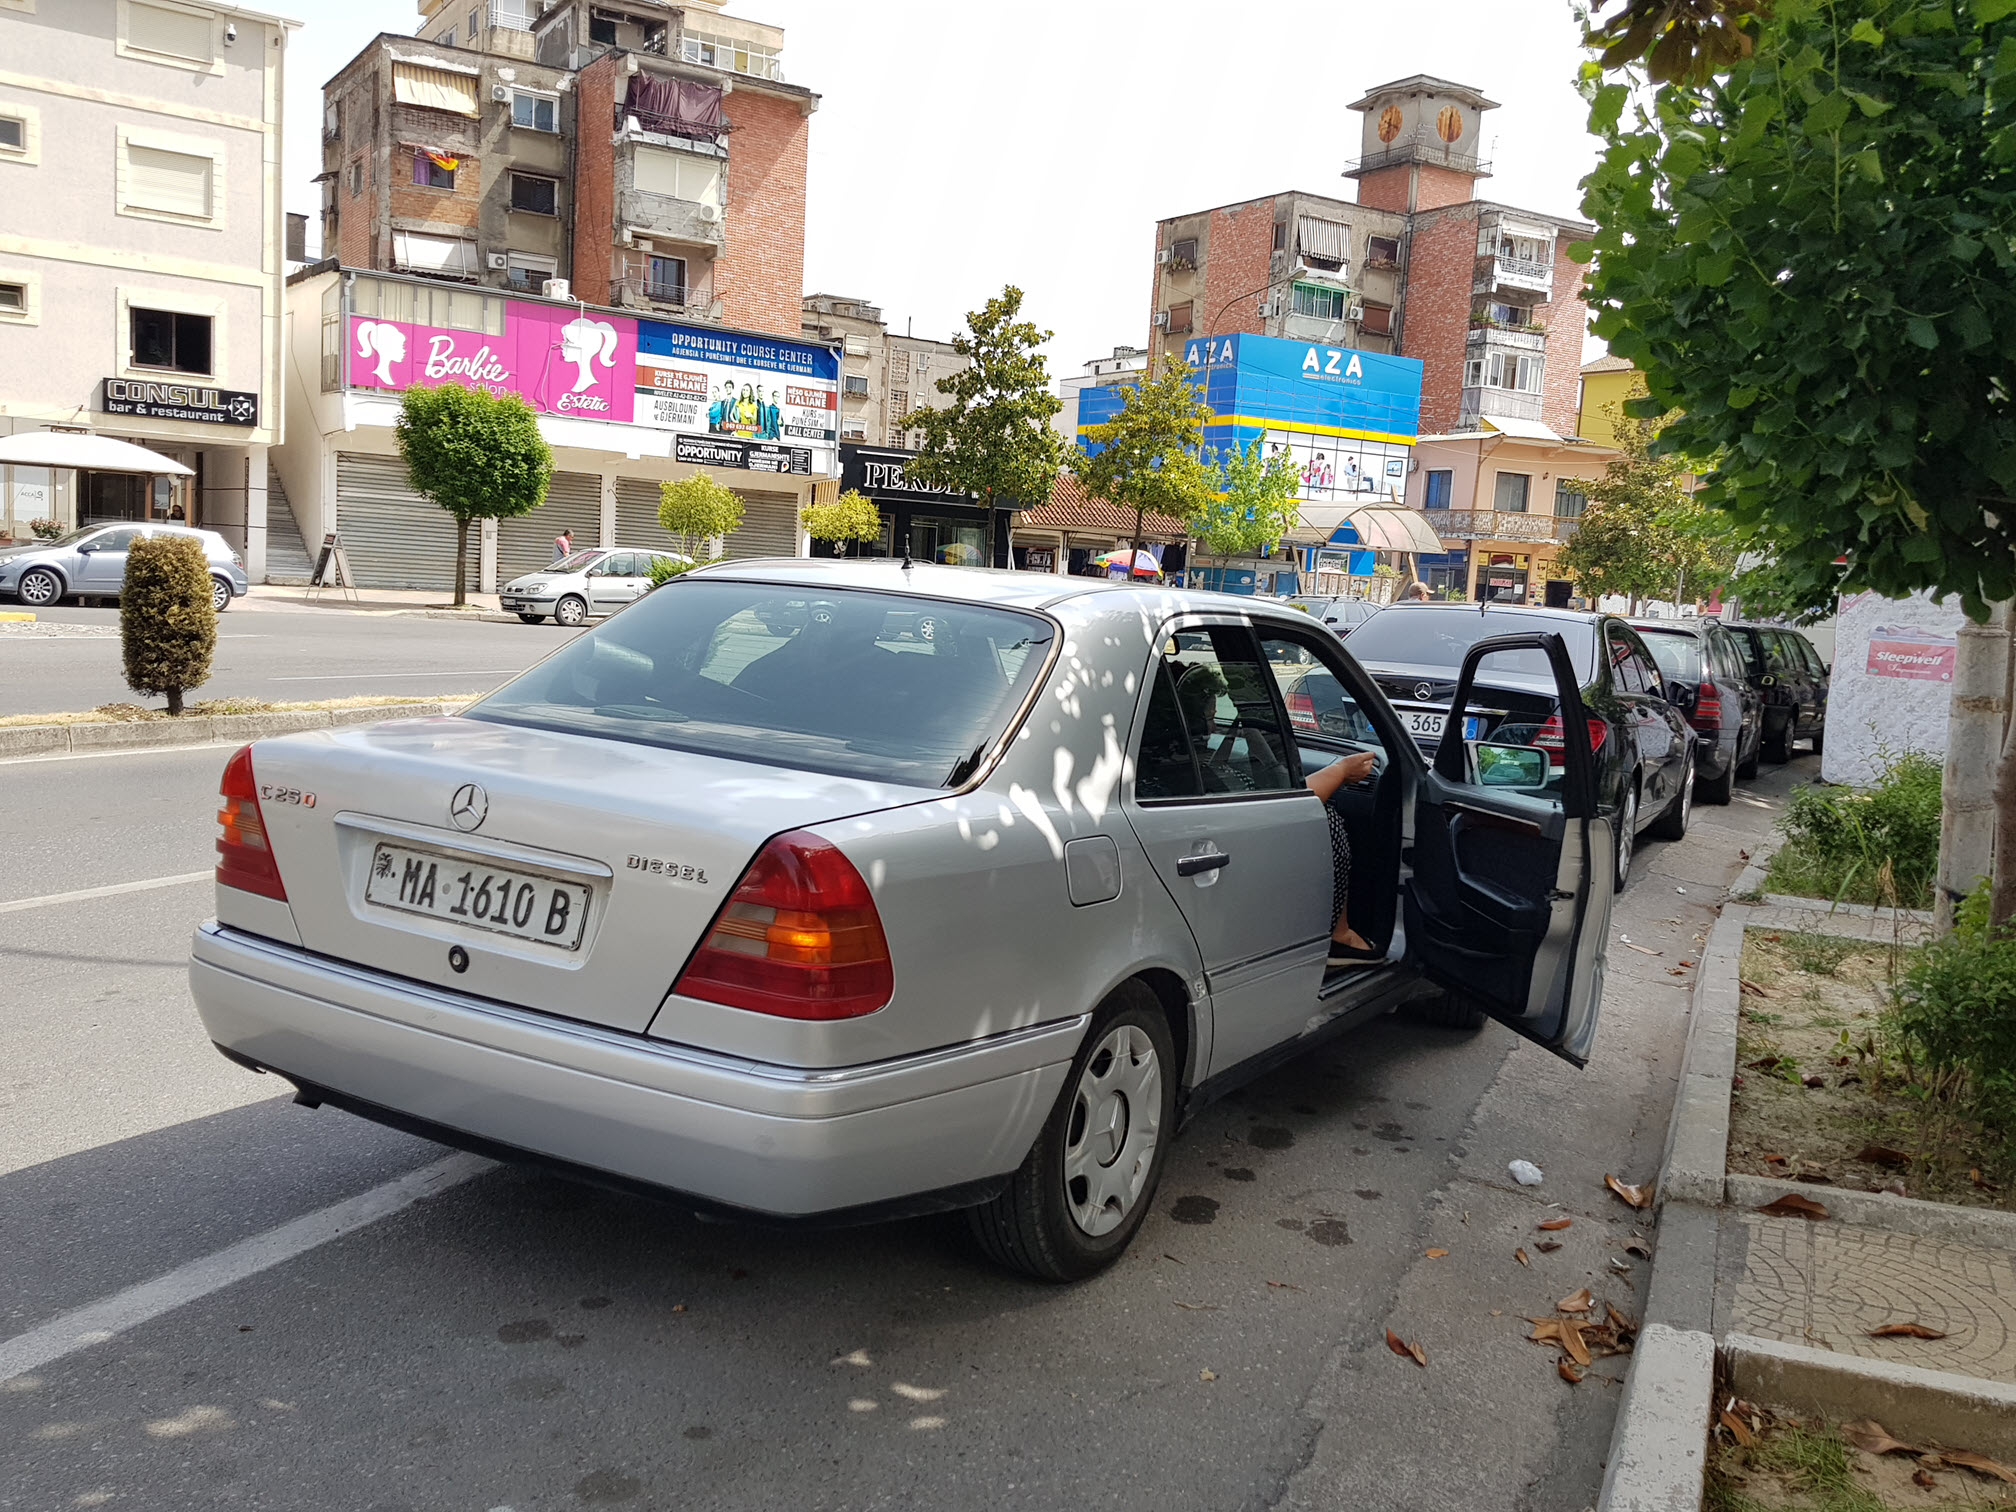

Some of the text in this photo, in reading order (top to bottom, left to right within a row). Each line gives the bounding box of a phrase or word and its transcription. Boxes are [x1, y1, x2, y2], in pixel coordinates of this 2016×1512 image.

[424, 335, 509, 381] Barbie
[672, 333, 813, 365] OPPORTUNITY COURSE CENTER
[1187, 339, 1234, 366] AZA
[672, 347, 699, 358] AGJENSIA
[700, 351, 704, 359] E
[748, 358, 752, 366] E
[787, 363, 813, 375] GJERMANI
[1302, 347, 1363, 378] AZA
[654, 370, 674, 379] KURSE
[1319, 373, 1362, 386] electronics
[654, 377, 708, 393] GJERMANE
[108, 380, 227, 411] CONSUL
[556, 392, 610, 412] Estetic
[787, 394, 827, 408] ITALIANE
[109, 401, 225, 422] bar & restaurant
[654, 400, 698, 415] AUSBILDUNG
[802, 409, 817, 419] KURS
[660, 411, 695, 425] GJERMANI
[788, 426, 825, 439] CALL CENTER
[677, 444, 742, 462] OPPORTUNITY
[1875, 651, 1943, 666] Sleepwell
[1411, 714, 1442, 733] 365
[627, 854, 708, 884] DIESEL
[400, 858, 571, 936] MA 1610 B
